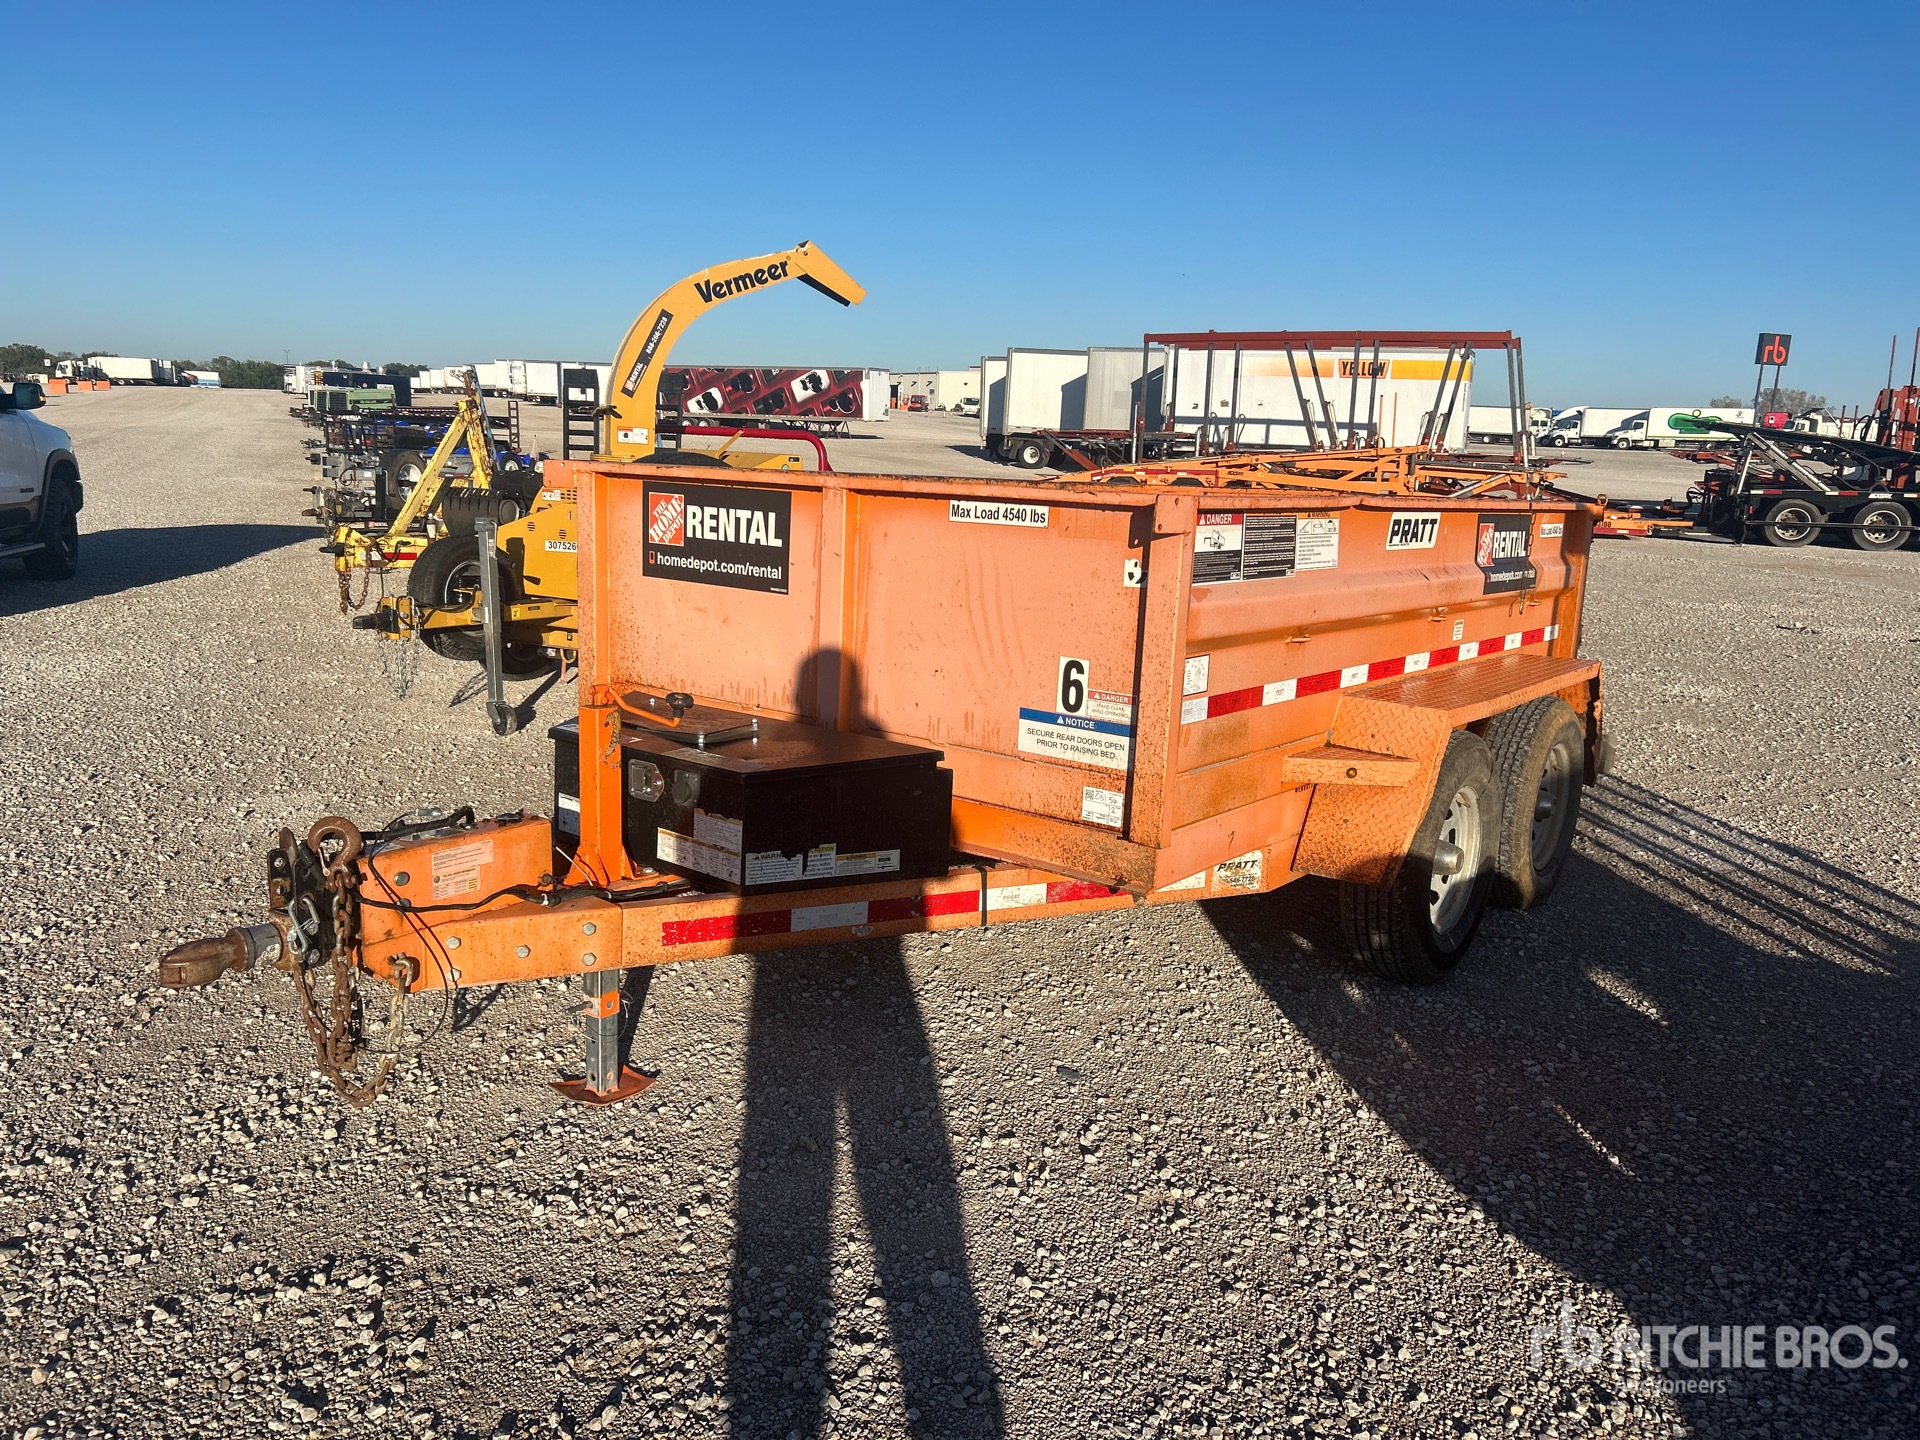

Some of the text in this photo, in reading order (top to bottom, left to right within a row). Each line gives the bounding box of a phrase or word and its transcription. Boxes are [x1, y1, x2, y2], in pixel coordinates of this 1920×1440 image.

[694, 260, 788, 303] Vermeer
[1763, 335, 1787, 364] rb
[649, 494, 684, 543] HOME
[652, 498, 668, 519] THE
[951, 504, 1046, 523] Max Load 4540 lbs
[1206, 513, 1233, 525] DANGER
[661, 513, 684, 544] DEPOT
[686, 504, 783, 548] RENTAL
[1389, 518, 1438, 544] PRATT
[548, 541, 578, 551] 307526
[1492, 531, 1527, 558] RENTAL
[657, 552, 782, 580] homedepot.com/rental
[1061, 659, 1085, 714] 6
[1101, 693, 1129, 703] DANGER
[1065, 717, 1095, 729] NOTICE
[1027, 727, 1125, 751] SECURE REAR DOORS OPEN
[1036, 738, 1058, 749] PRIOR
[1059, 742, 1069, 751] TO
[1070, 744, 1099, 757] RAISING
[1217, 859, 1258, 872] PRATT
